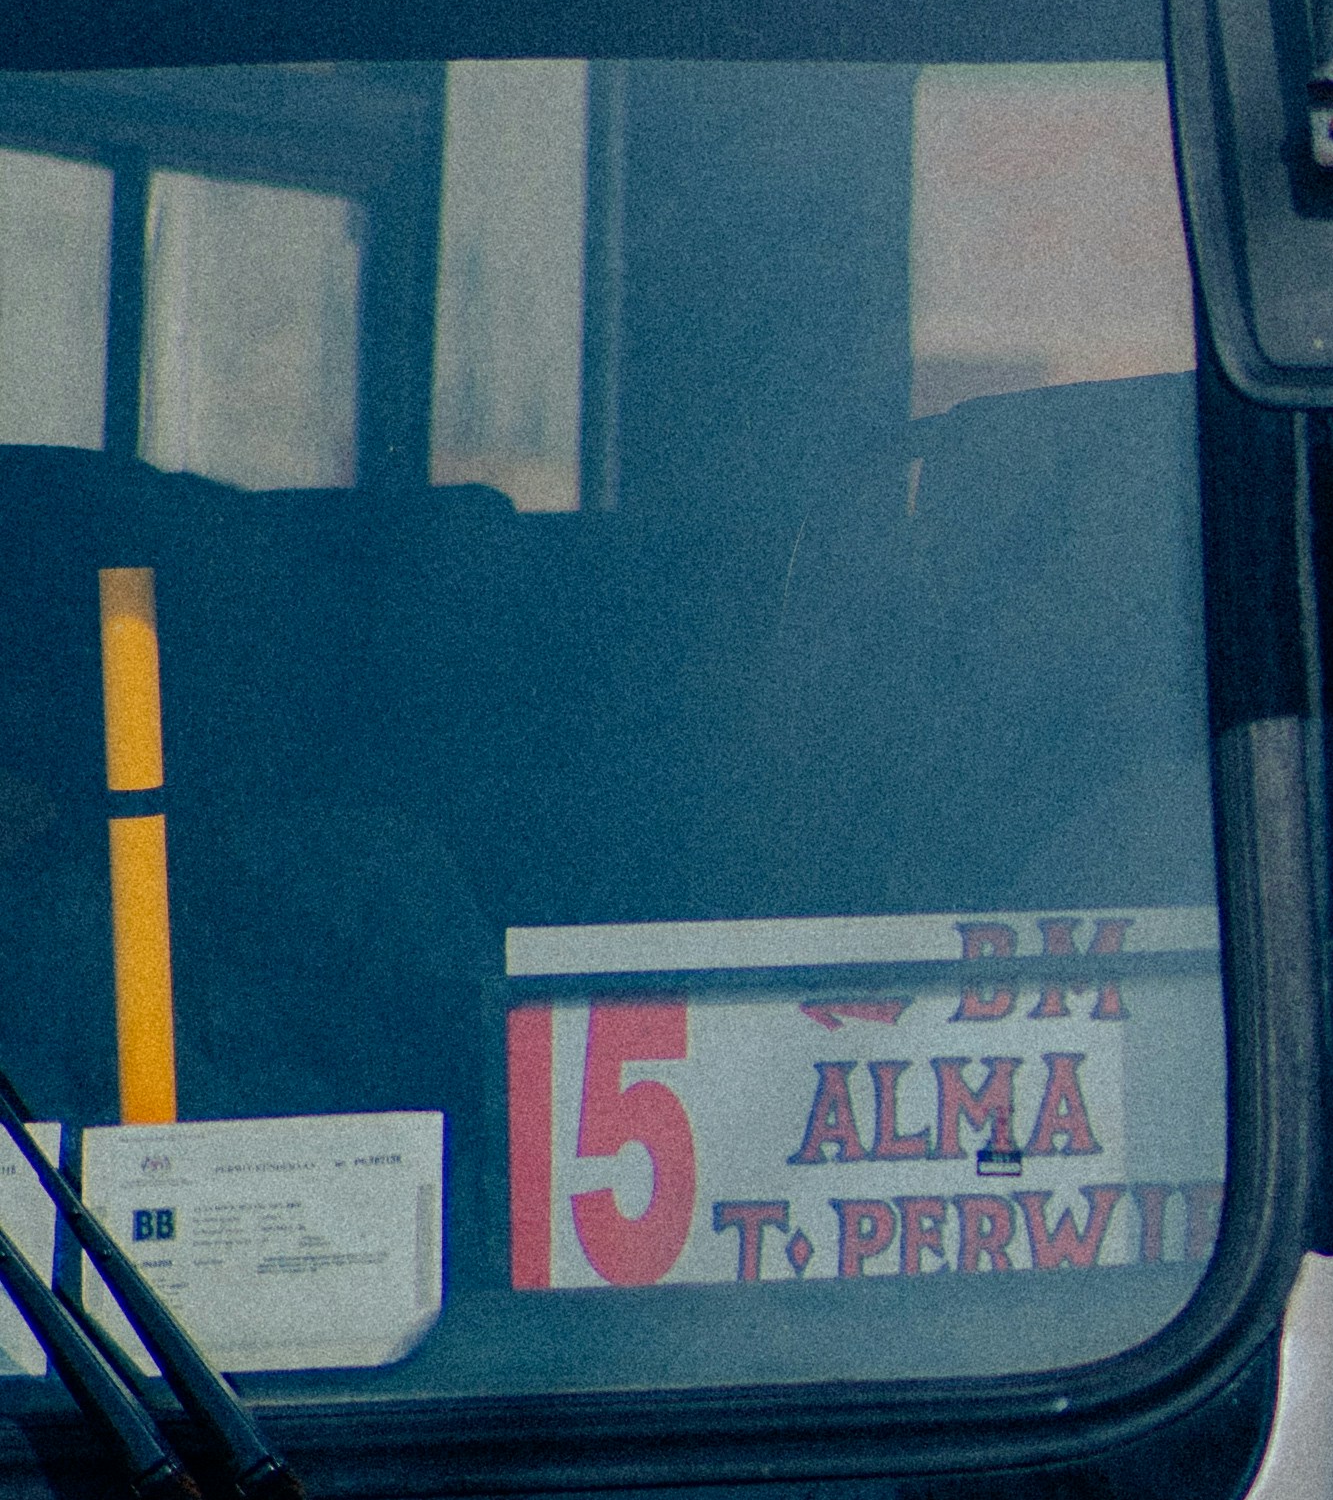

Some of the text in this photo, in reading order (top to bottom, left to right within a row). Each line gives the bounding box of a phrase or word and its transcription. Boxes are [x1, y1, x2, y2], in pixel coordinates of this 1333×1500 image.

[948, 916, 1136, 1024] BM
[507, 997, 697, 1290] 15
[787, 1052, 1103, 1164] ALMA
